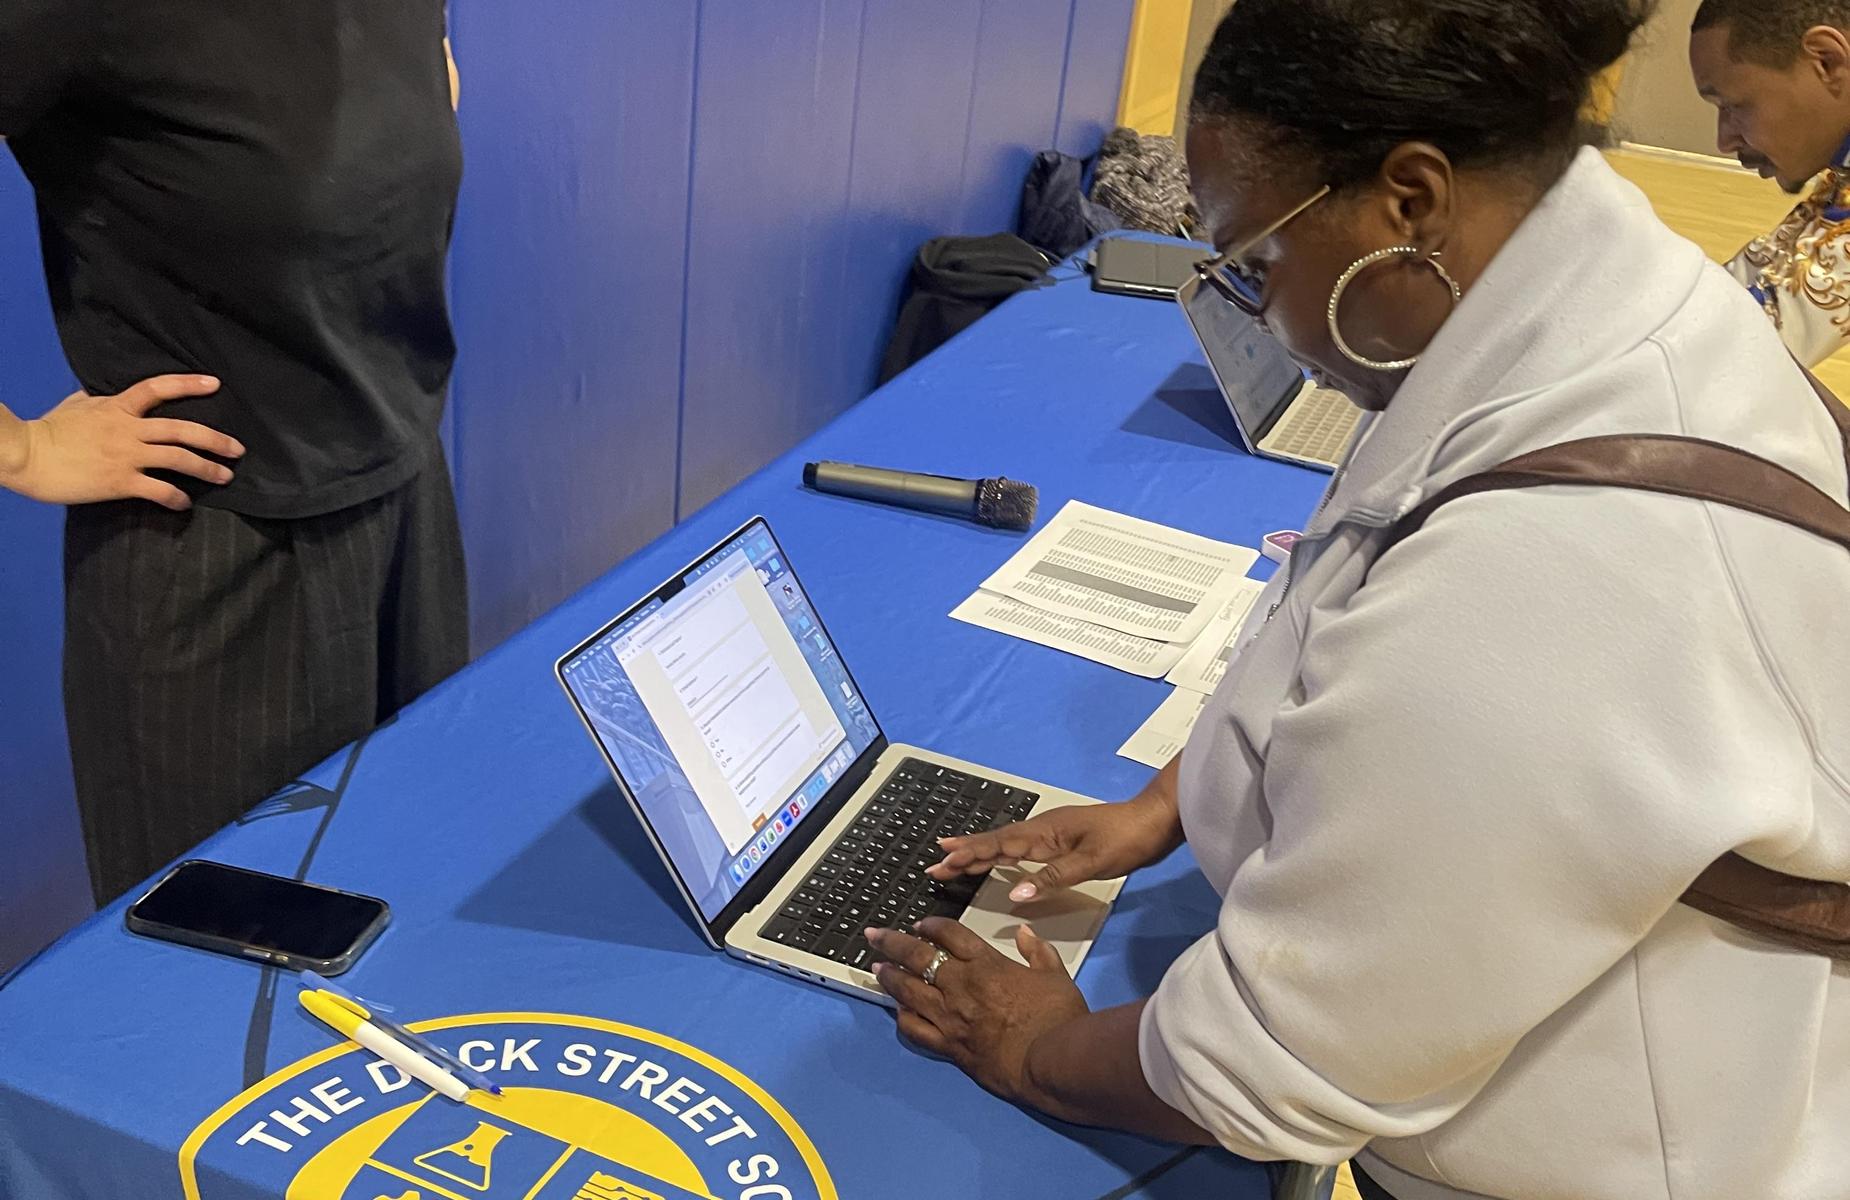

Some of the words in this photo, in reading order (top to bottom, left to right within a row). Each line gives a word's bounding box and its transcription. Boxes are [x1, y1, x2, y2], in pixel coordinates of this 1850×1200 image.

[236, 1077, 366, 1152] THE
[365, 1038, 542, 1094] DCK
[556, 1043, 758, 1147] STREET
